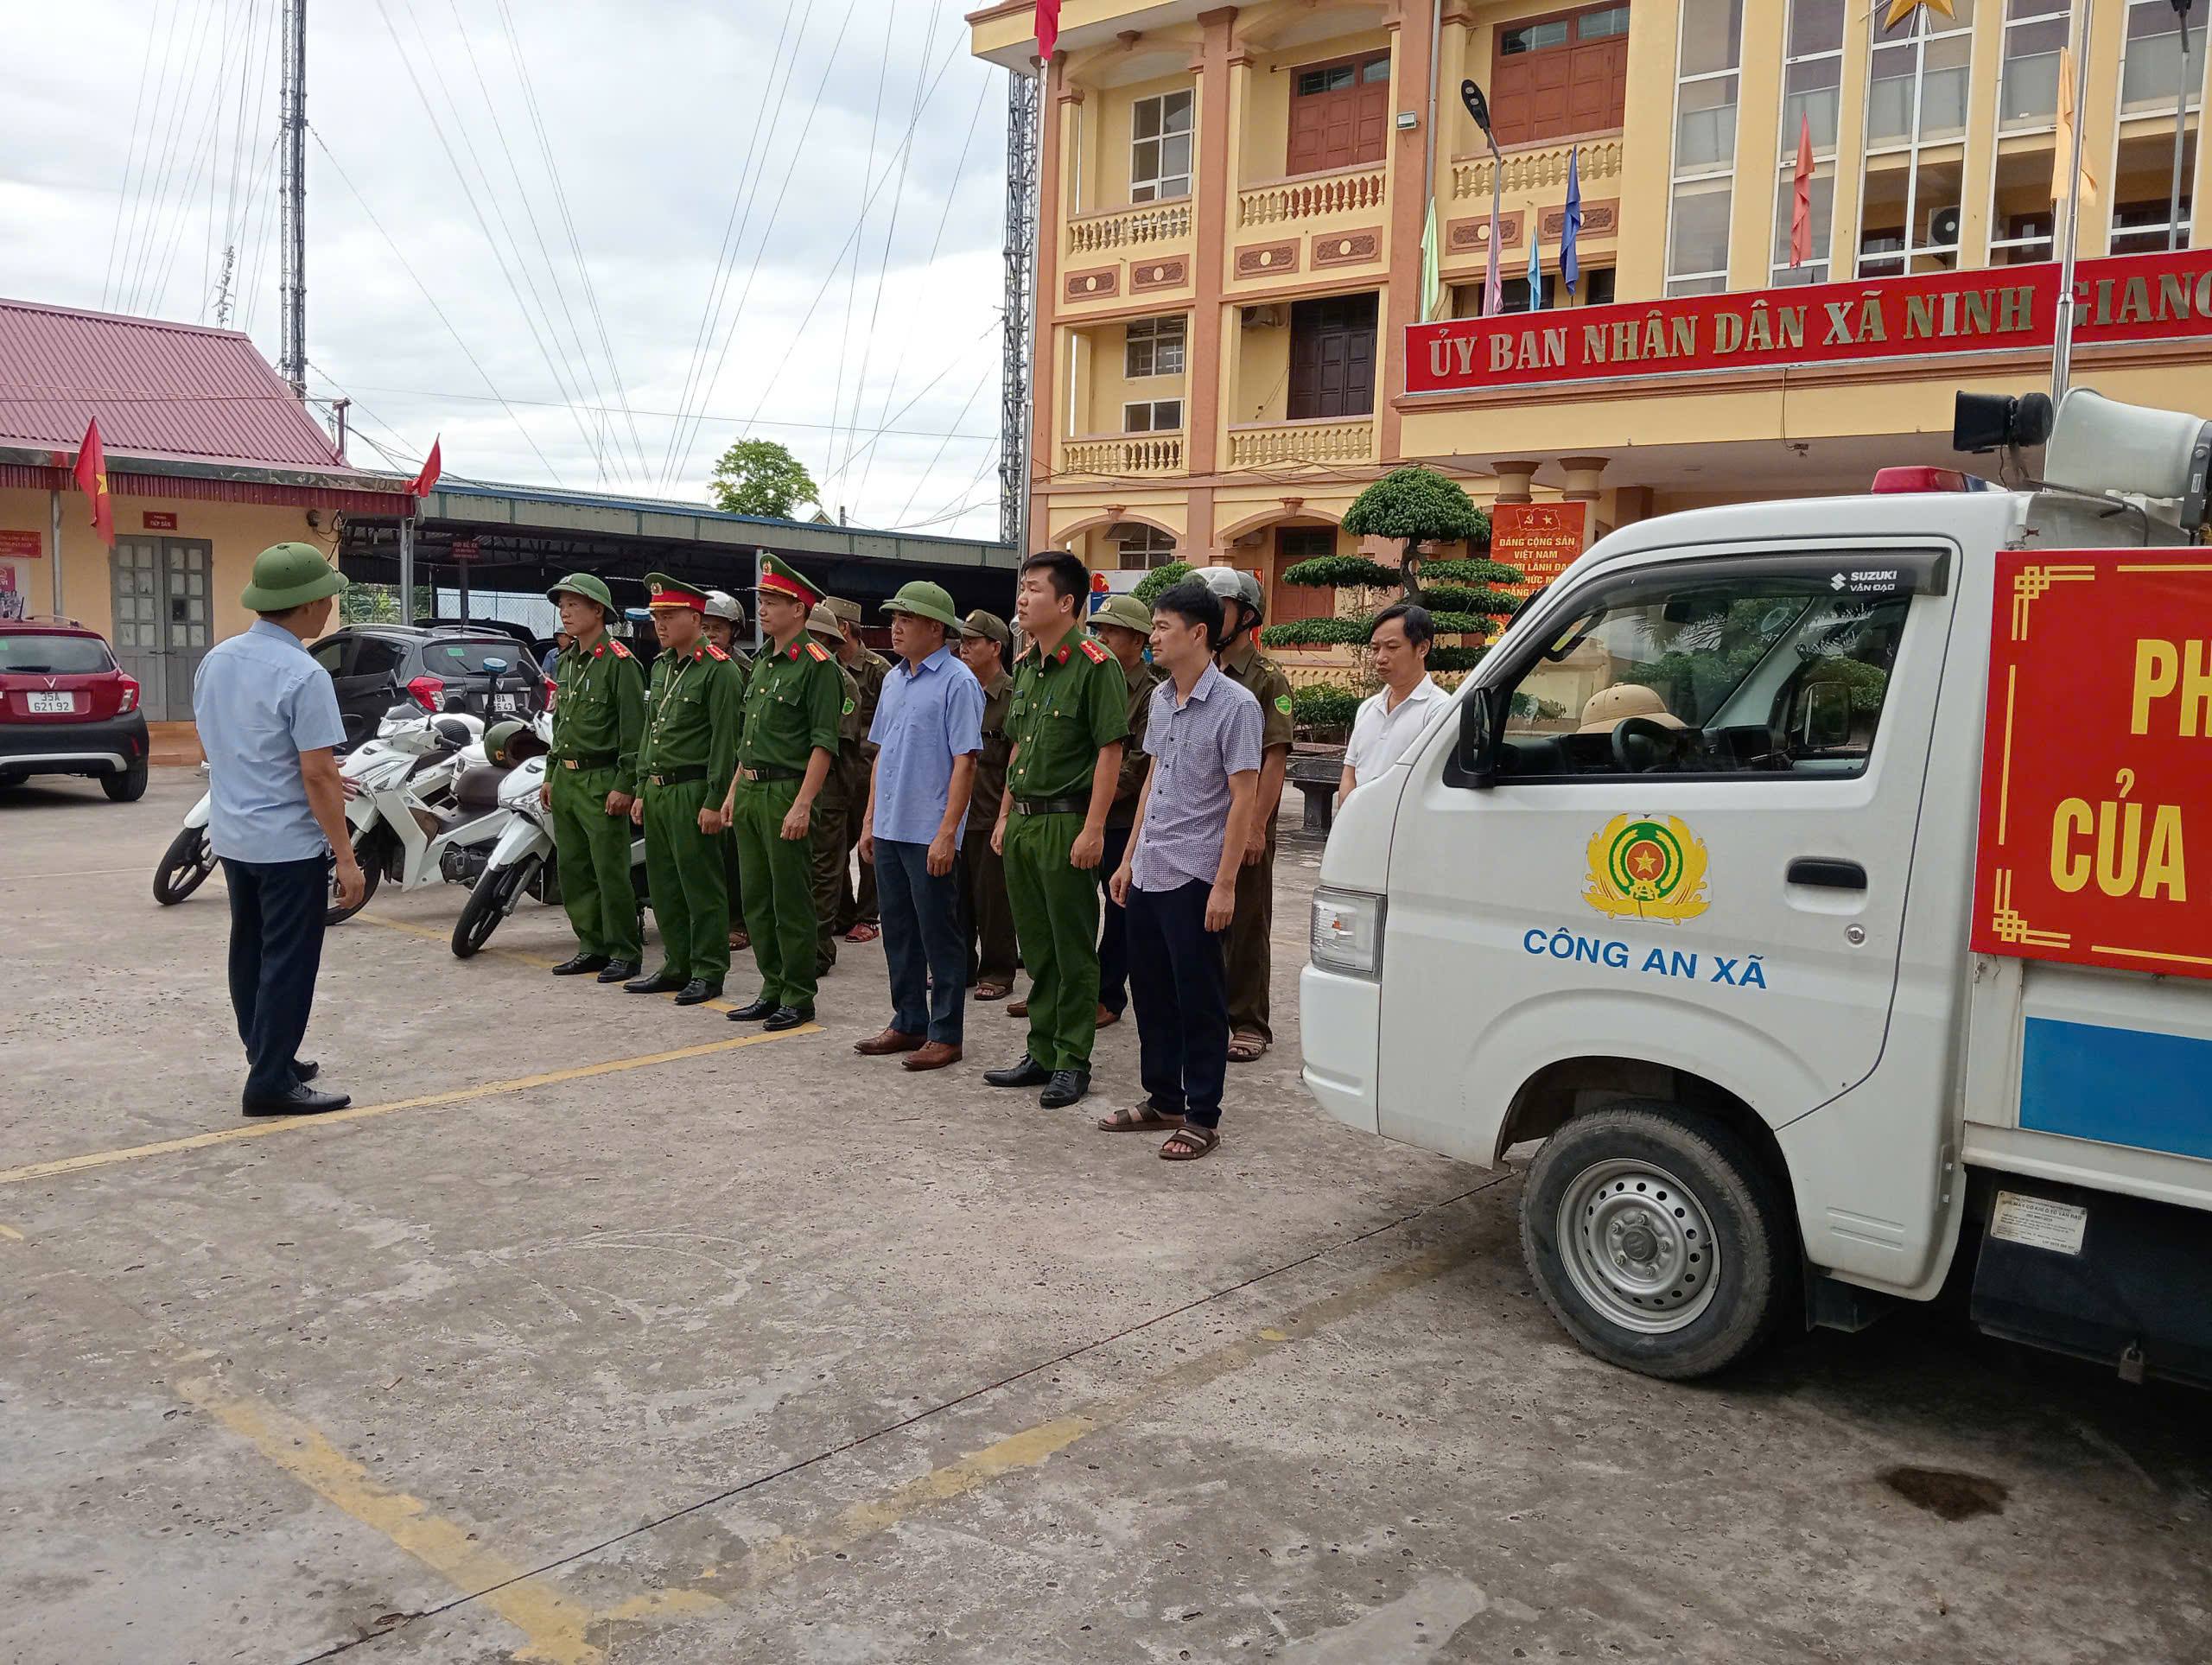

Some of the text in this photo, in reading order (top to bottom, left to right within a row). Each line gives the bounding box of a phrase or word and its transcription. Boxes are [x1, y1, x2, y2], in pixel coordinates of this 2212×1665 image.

[1429, 328, 1478, 377] ỦY
[1488, 327, 1568, 372] BAN
[1582, 309, 1699, 365] NHÂN
[1713, 299, 1808, 355] DÂN
[1822, 289, 1888, 346] XÃ
[1903, 285, 2037, 340] NINH
[1499, 535, 1575, 549] ĐẢNG CỘNG SẢN
[1514, 550, 1558, 561] VIỆT NAM
[1527, 562, 1552, 571] LÃNH
[1850, 570, 1897, 581] SUZUKI
[40, 691, 60, 702] 35A
[2050, 767, 2187, 902] CỦA
[1523, 926, 1768, 989] CÔNG AN XÃ
